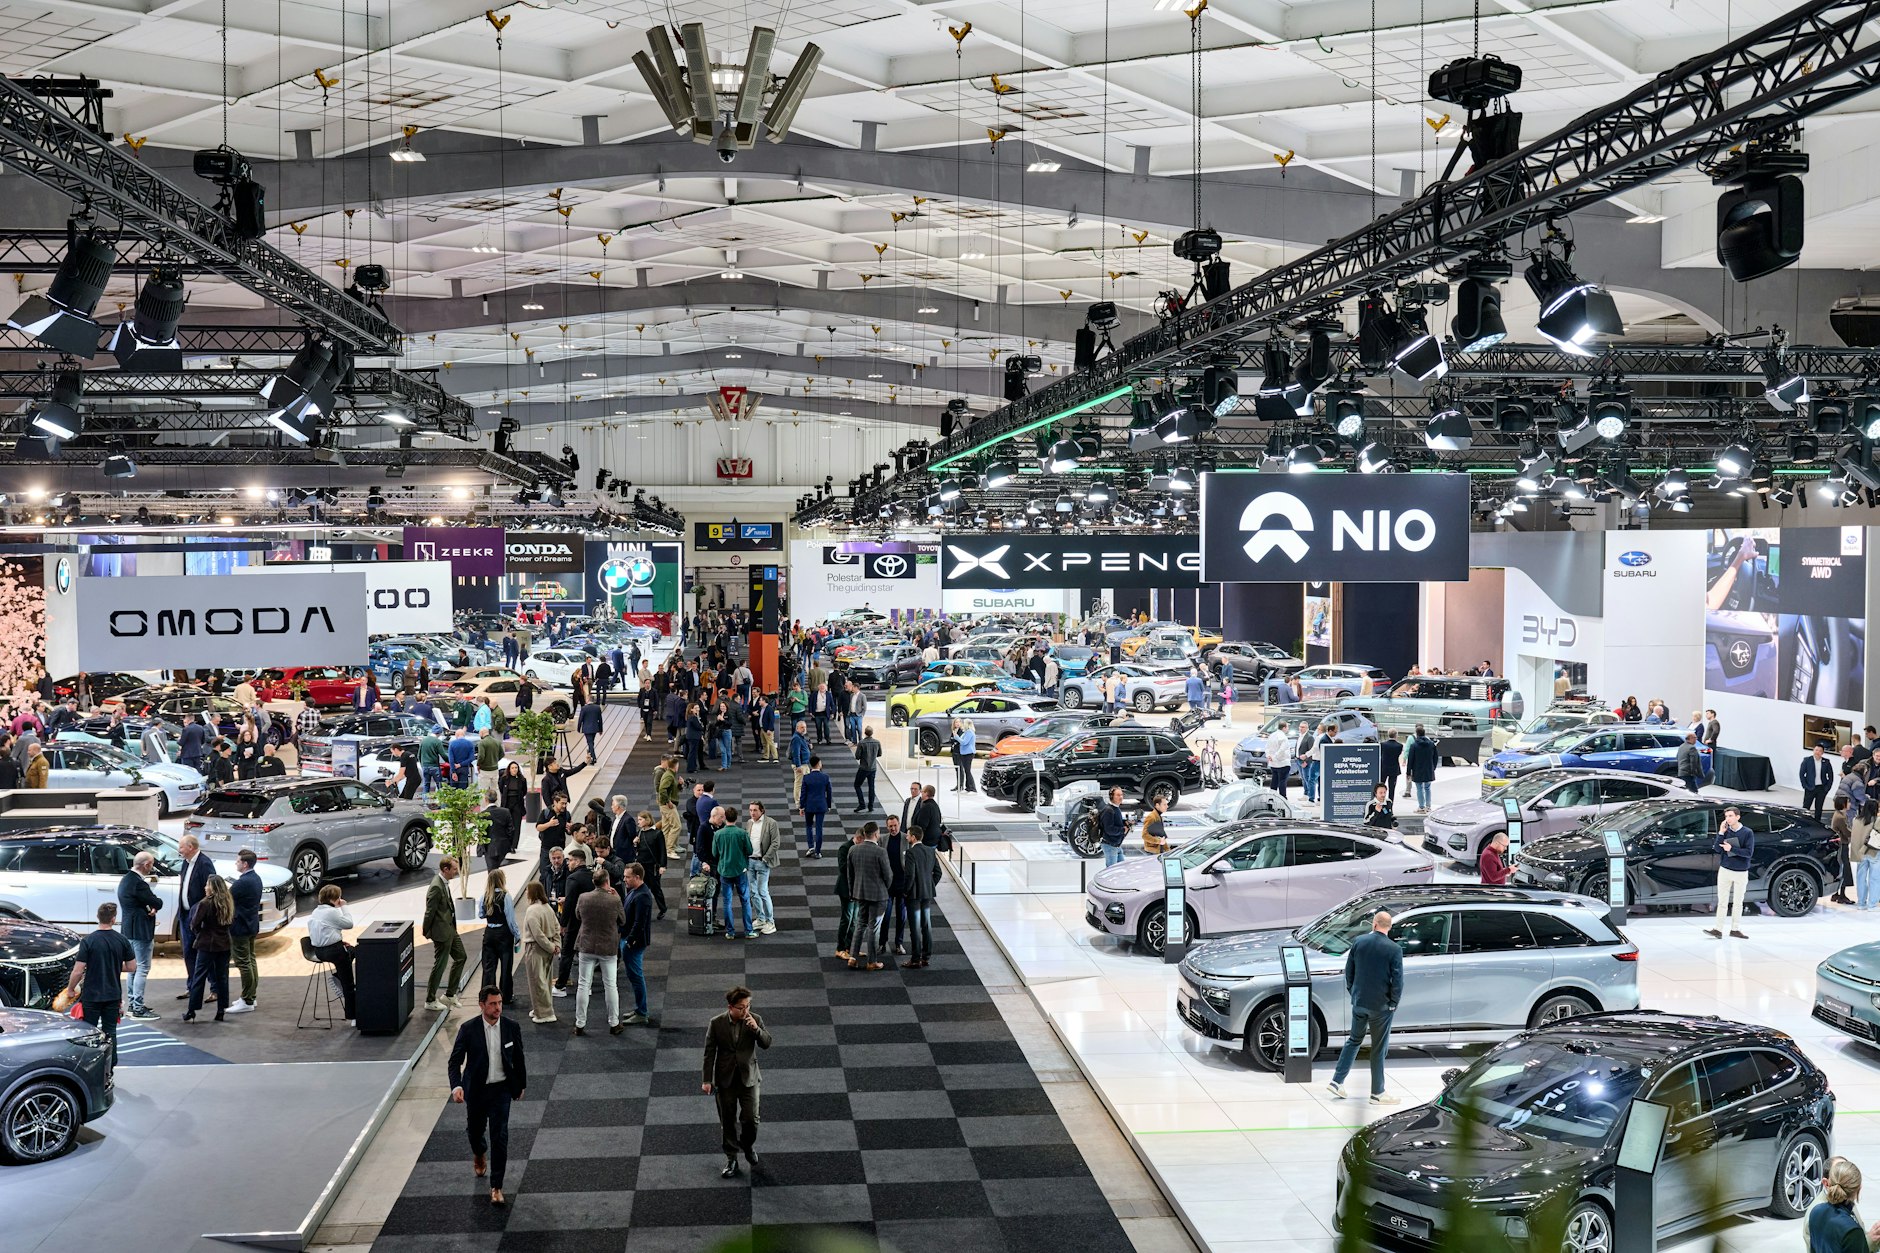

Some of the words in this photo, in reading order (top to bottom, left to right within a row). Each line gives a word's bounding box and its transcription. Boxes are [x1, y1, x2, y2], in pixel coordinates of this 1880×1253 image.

[726, 390, 740, 409] 7
[712, 528, 719, 536] 9
[1332, 509, 1436, 552] NIO
[441, 548, 494, 557] ZEEKR
[1023, 552, 1200, 571] XPENG
[1802, 557, 1842, 566] SYMMETRICAL
[827, 573, 862, 582] Polestar
[1811, 567, 1832, 578] AWD
[828, 583, 844, 592] The
[845, 583, 876, 593] guiding
[973, 598, 1034, 607] SUBARU
[110, 606, 335, 637] OMODA
[1523, 615, 1577, 647] BYD
